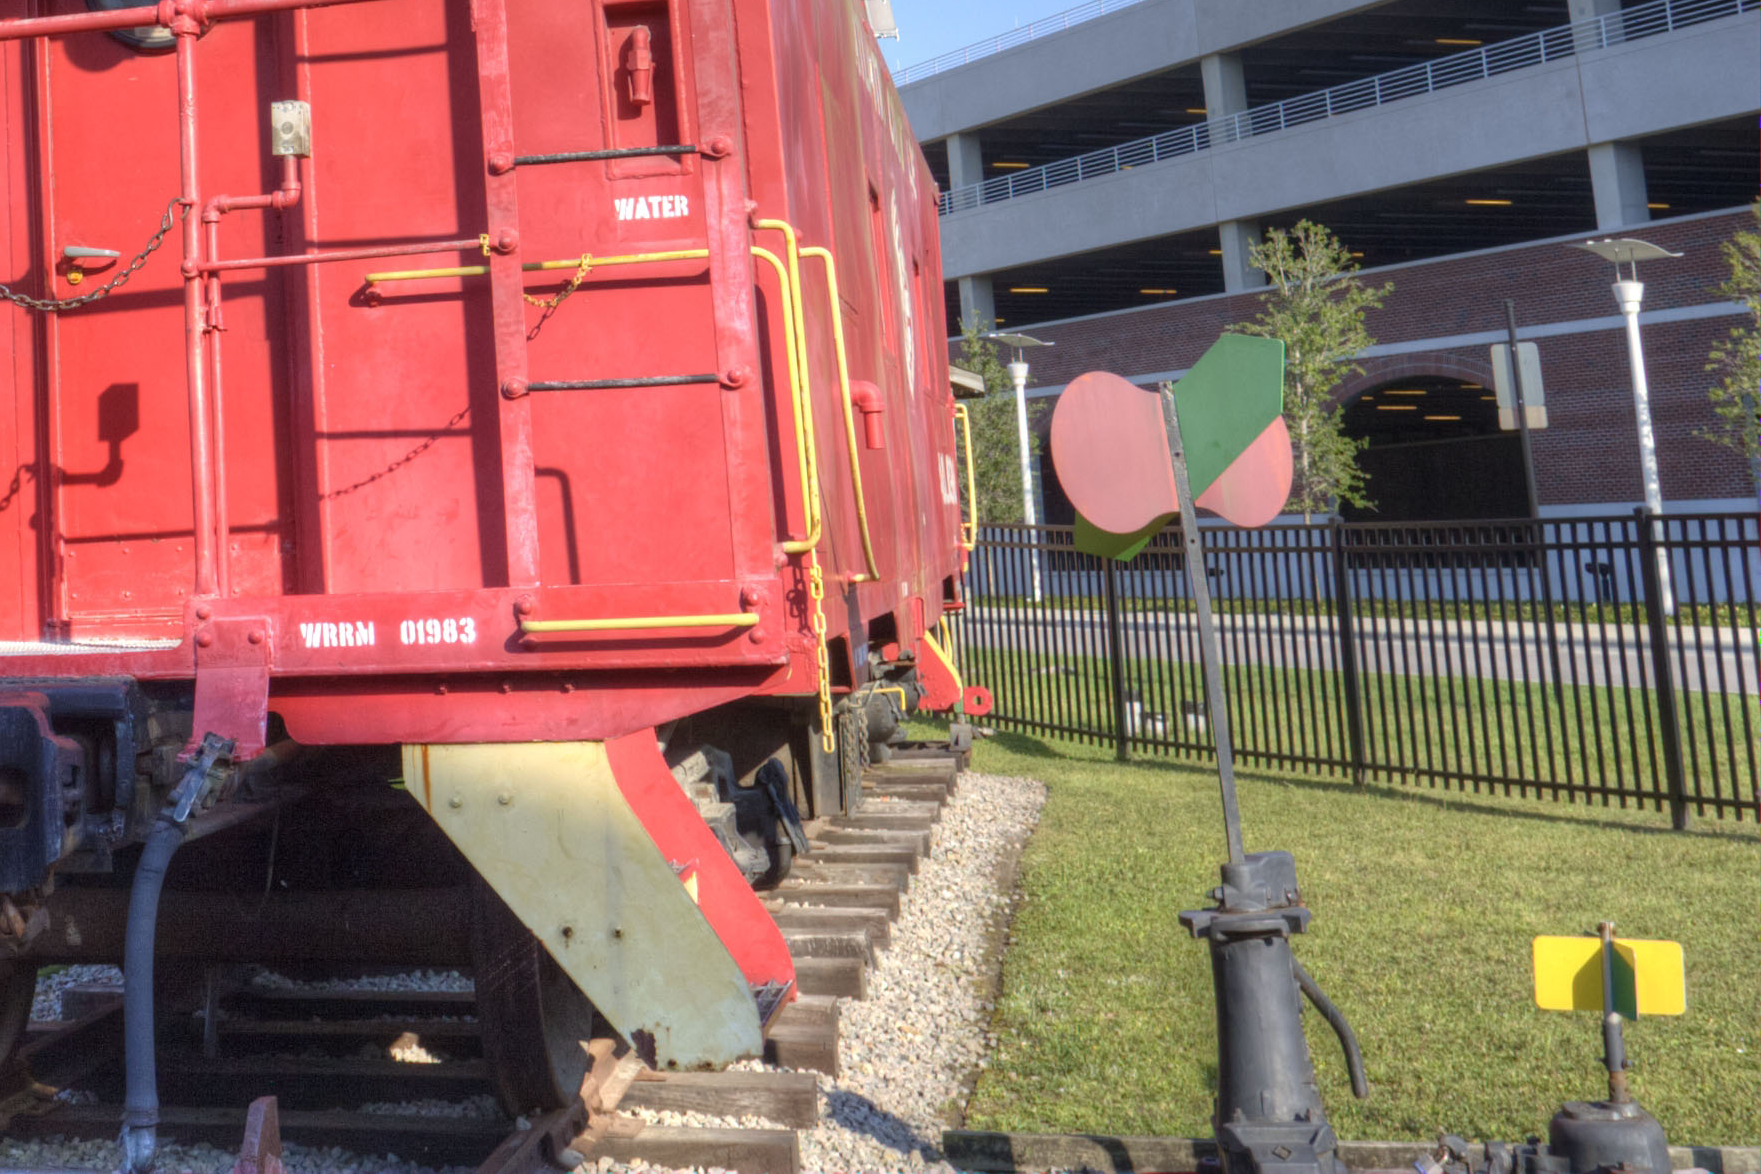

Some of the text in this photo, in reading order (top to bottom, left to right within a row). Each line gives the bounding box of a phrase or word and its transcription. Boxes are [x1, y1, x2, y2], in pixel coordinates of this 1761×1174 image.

[614, 194, 689, 221] WATER
[299, 616, 477, 648] WRRM 01983
